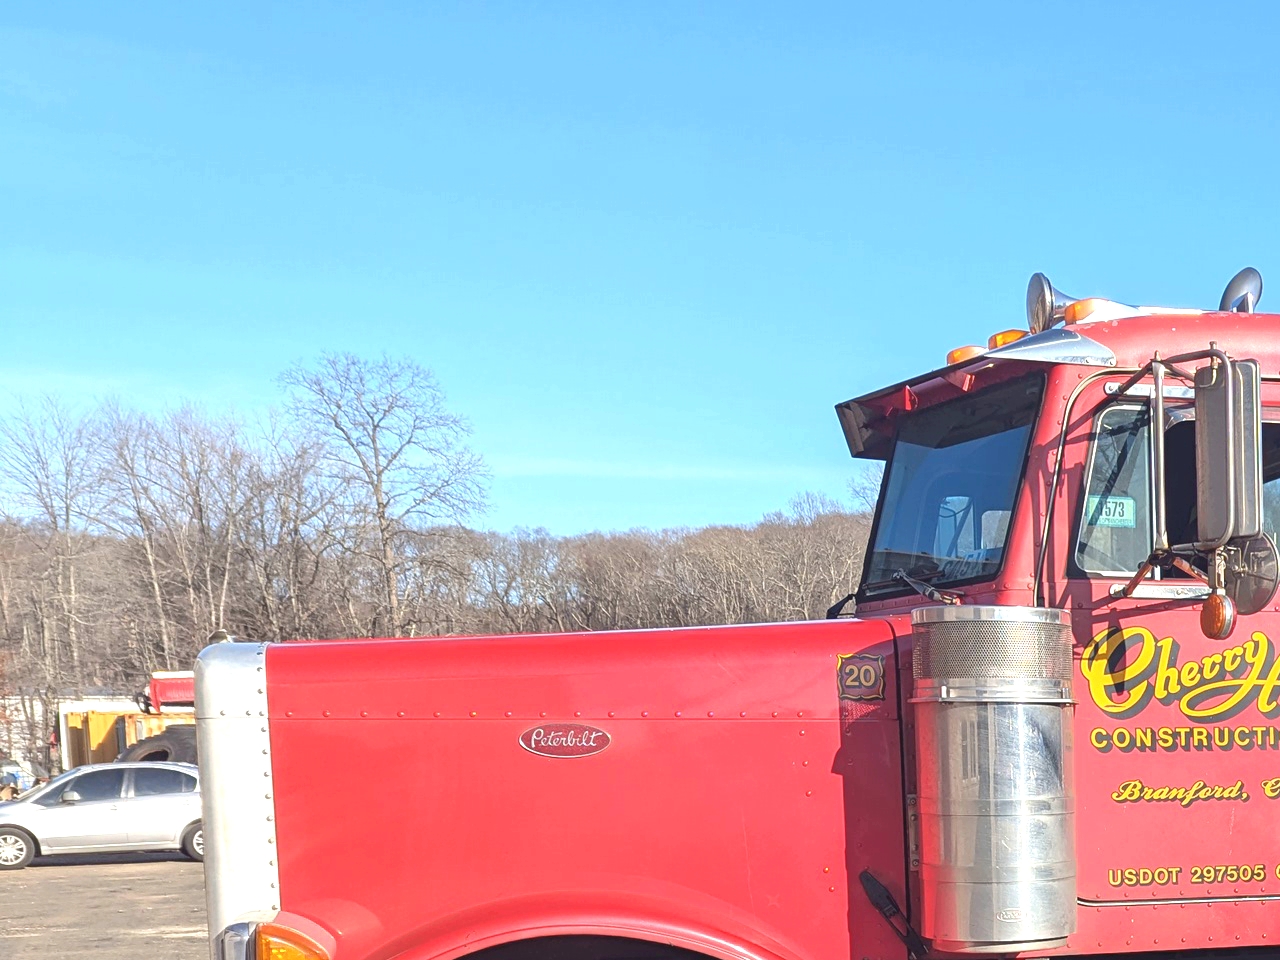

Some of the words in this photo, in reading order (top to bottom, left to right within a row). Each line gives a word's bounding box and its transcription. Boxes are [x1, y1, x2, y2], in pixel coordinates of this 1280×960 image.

[845, 664, 875, 688] 20
[1080, 625, 1274, 719] Cherry
[530, 727, 605, 749] Peterbilt
[1111, 779, 1250, 806] Branford,
[1108, 866, 1180, 887] USDOT
[1190, 864, 1267, 884] 297505
